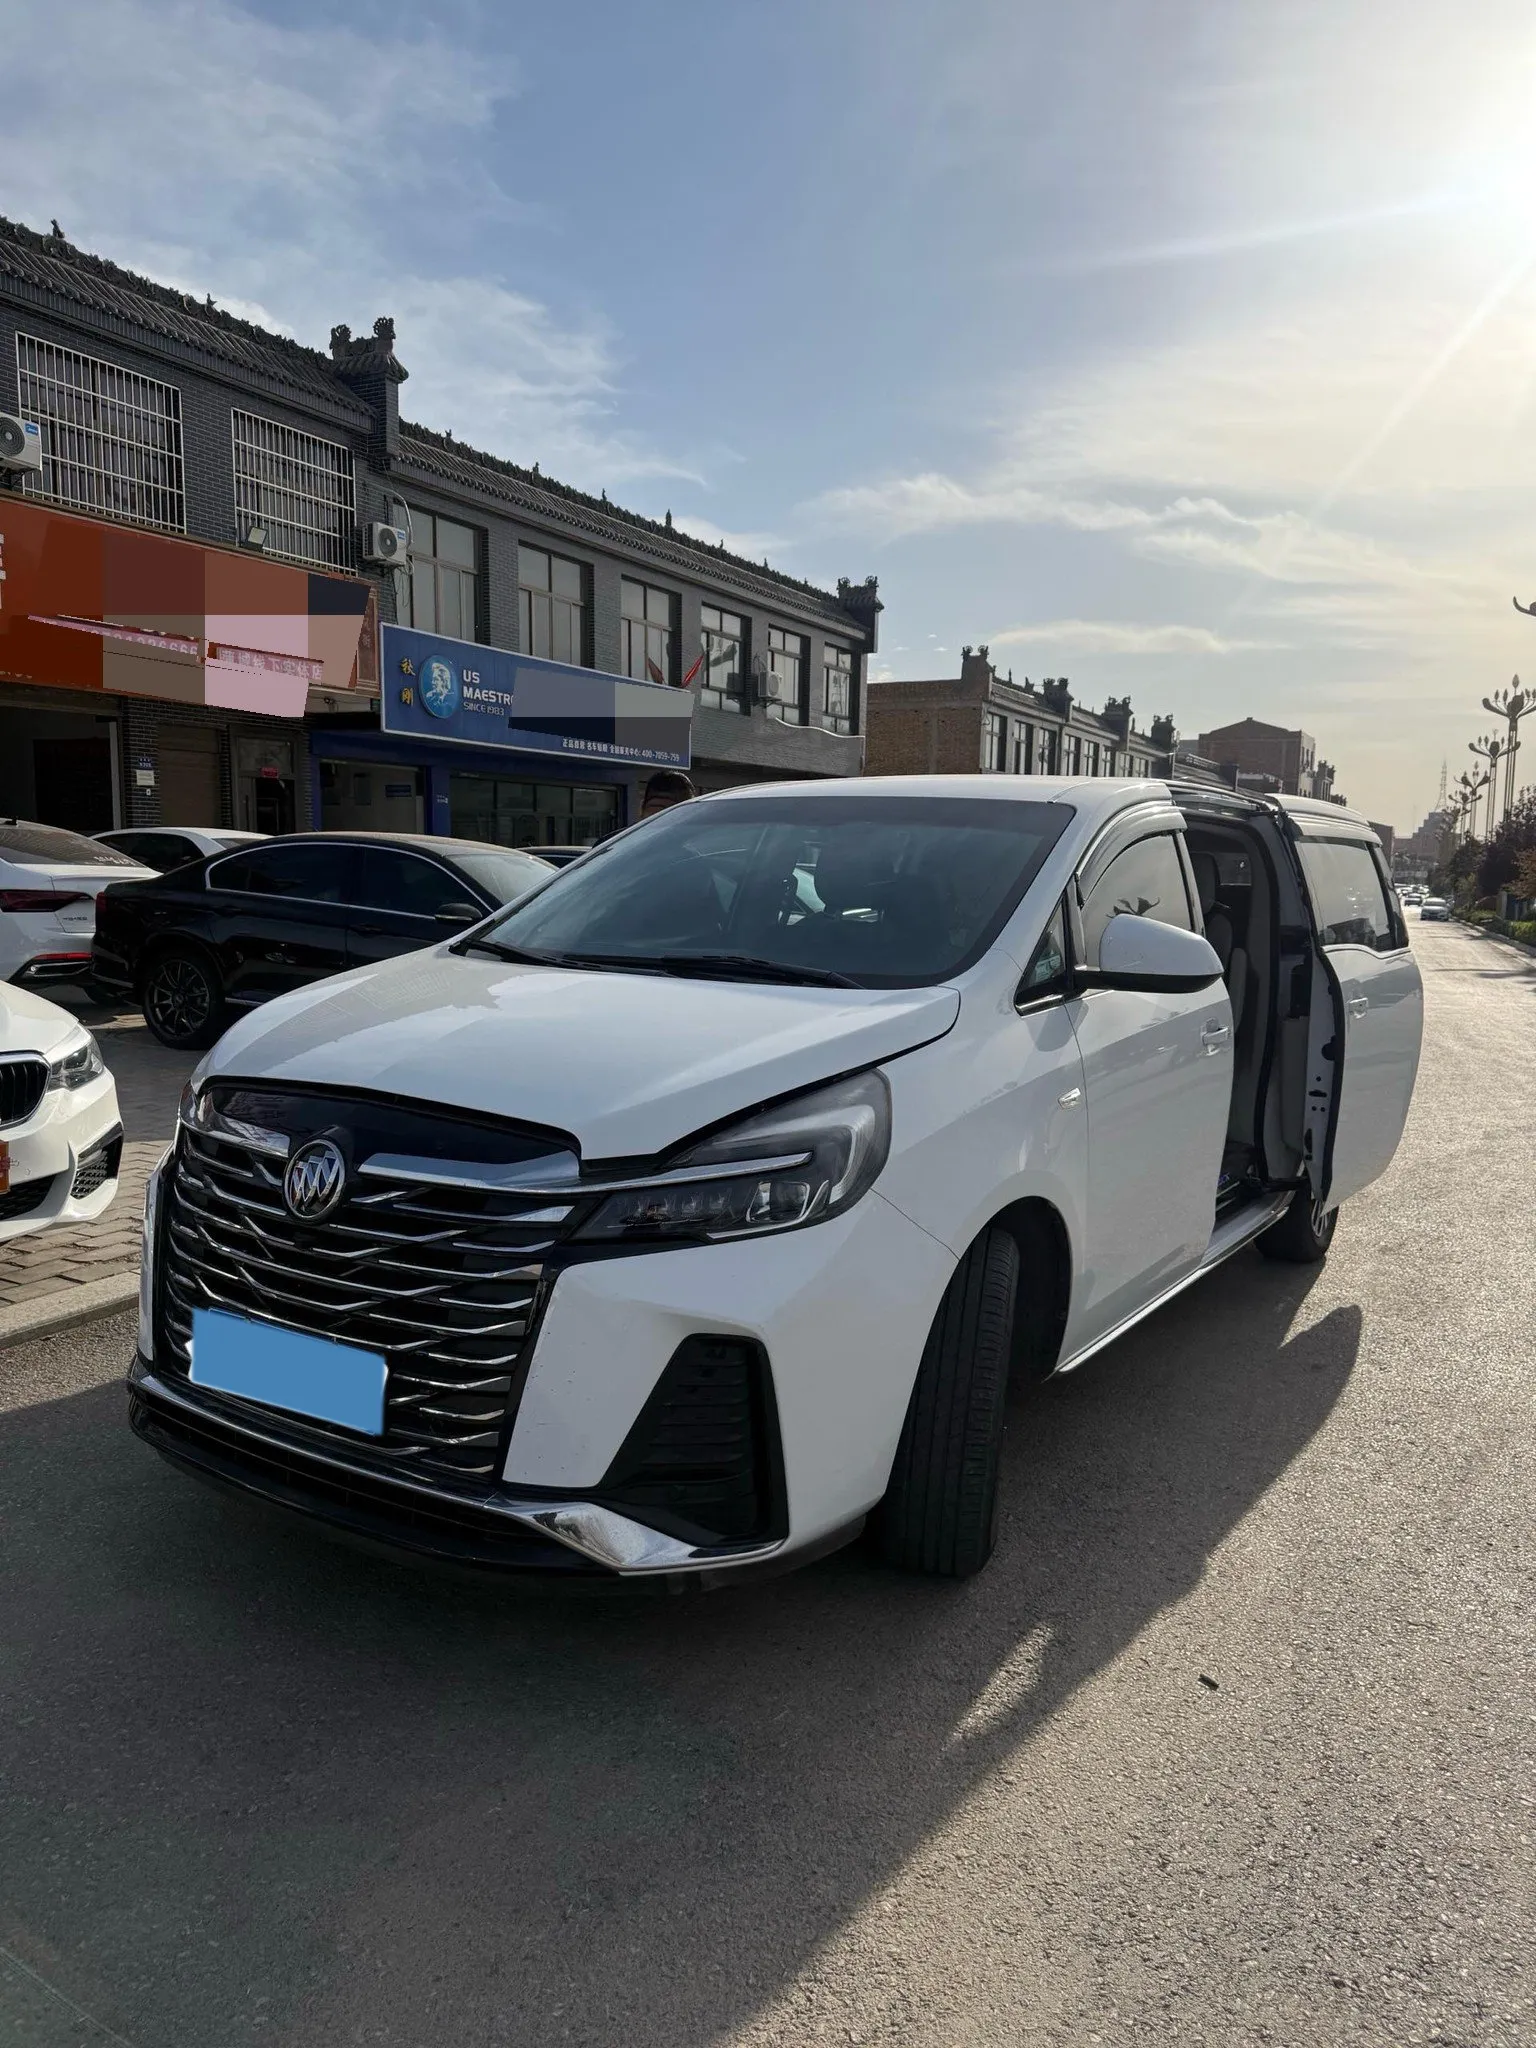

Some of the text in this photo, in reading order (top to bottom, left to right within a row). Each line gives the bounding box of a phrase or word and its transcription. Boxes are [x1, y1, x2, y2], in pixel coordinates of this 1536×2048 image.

[463, 669, 480, 684] US
[463, 701, 505, 716] SINCE 1983
